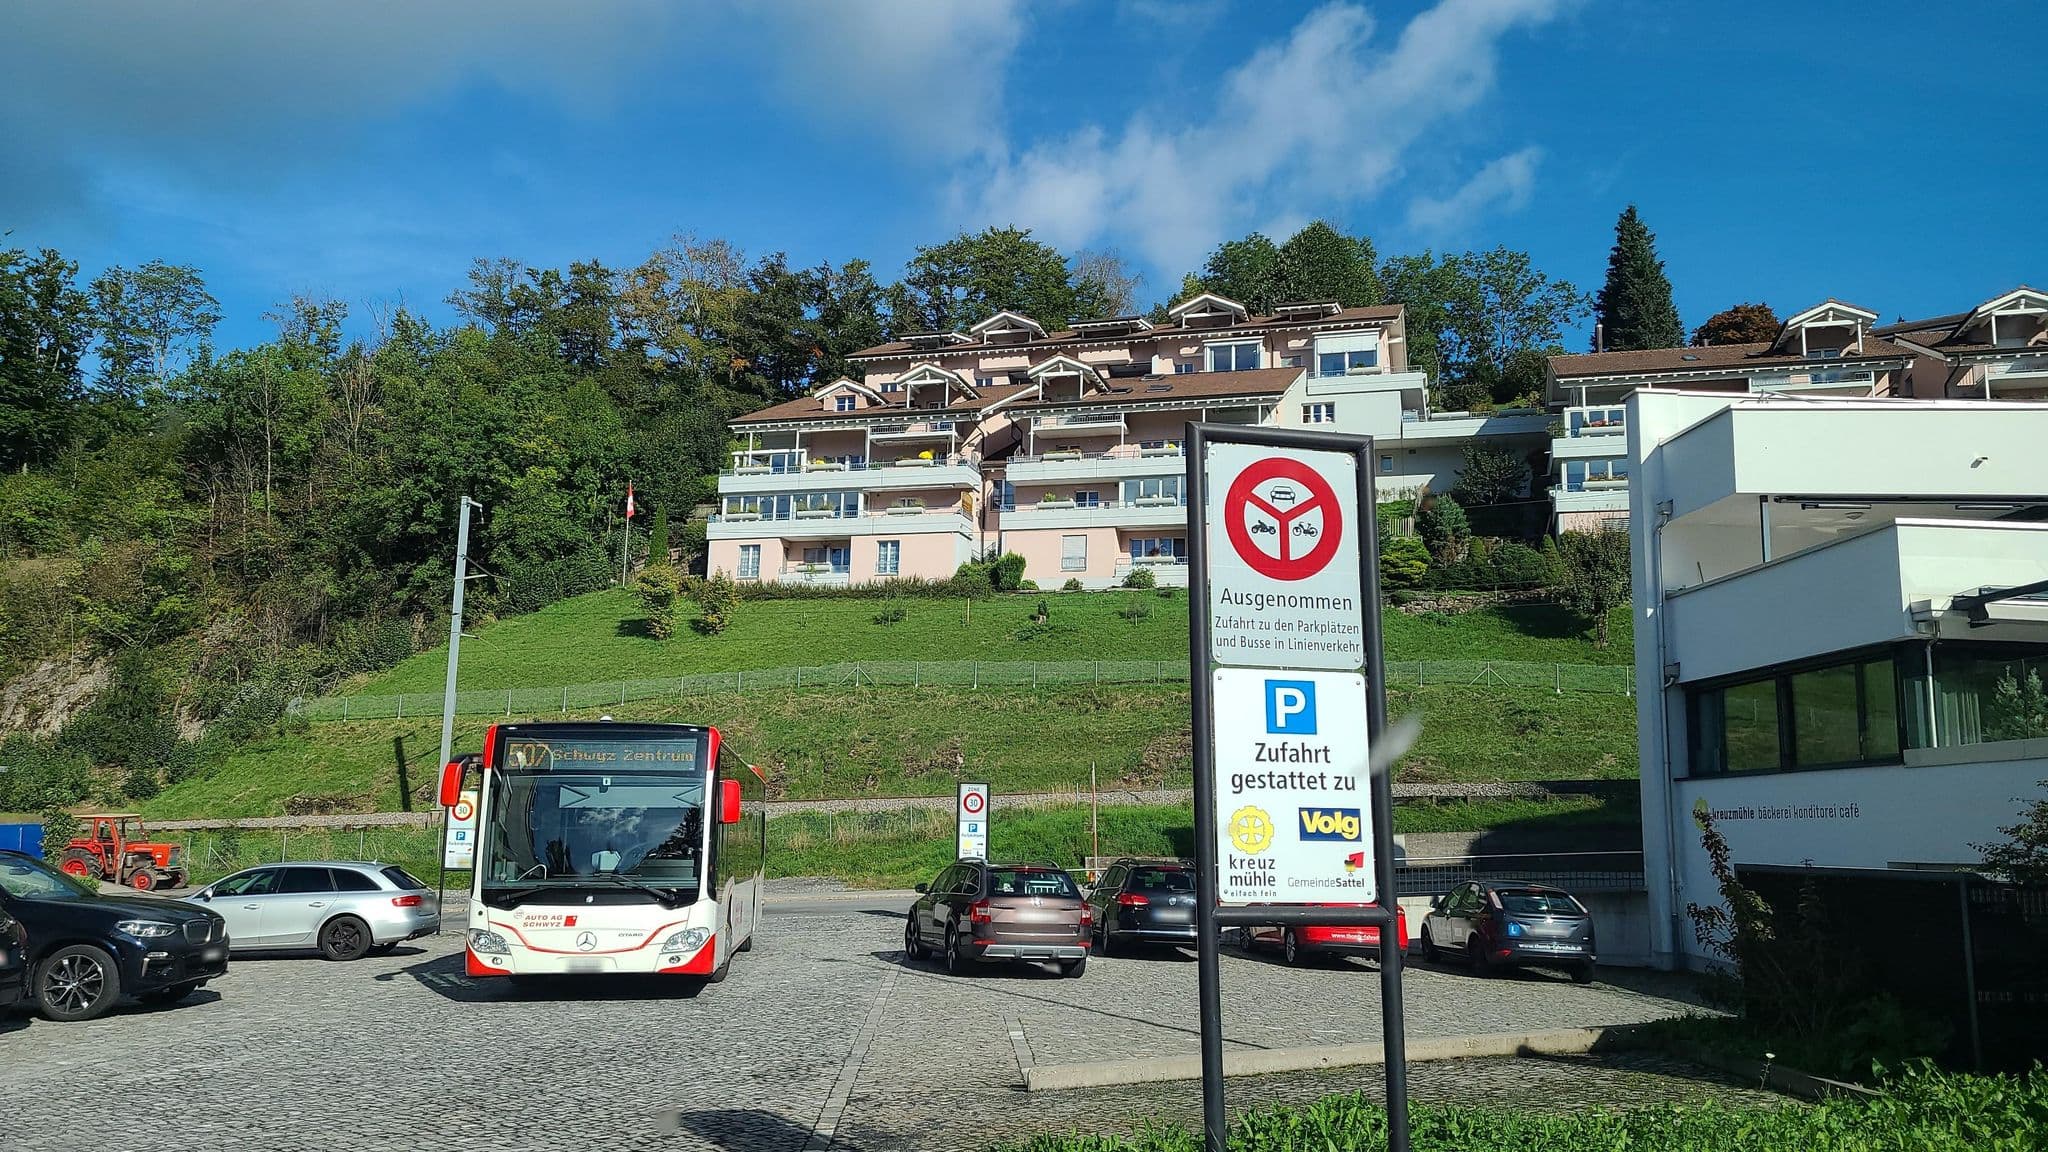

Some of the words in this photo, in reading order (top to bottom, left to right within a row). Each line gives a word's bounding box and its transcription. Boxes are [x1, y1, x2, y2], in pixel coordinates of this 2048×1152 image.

[1220, 588, 1353, 611] Ausgenommen
[1215, 615, 1256, 631] Zufahrt
[1258, 620, 1271, 631] zu
[1274, 618, 1294, 632] den
[1297, 620, 1360, 637] Parkplätzen
[1216, 634, 1236, 648] und
[1240, 635, 1271, 650] Busse
[1274, 636, 1285, 650] in
[1288, 638, 1360, 654] Linienverkehr
[1275, 687, 1306, 728] P
[508, 743, 550, 768] 507
[552, 748, 617, 763] Schwyz
[623, 749, 694, 763] Zentrum
[1255, 742, 1331, 764] Zufahrt
[1231, 771, 1327, 795] gestattet
[1334, 775, 1356, 791] zu
[458, 806, 468, 815] 30
[969, 798, 978, 807] 30
[1712, 806, 1755, 820] kreuzmühle
[1758, 805, 1791, 820] bäckerei
[1793, 803, 1836, 819] konditorei
[1839, 802, 1860, 819] café
[1300, 810, 1360, 841] Volg
[1229, 853, 1276, 870] kreuz
[1229, 870, 1276, 887] mühle
[1287, 877, 1365, 888] GemeindeSattel
[1230, 889, 1258, 897] eifach
[1260, 889, 1277, 897] fein
